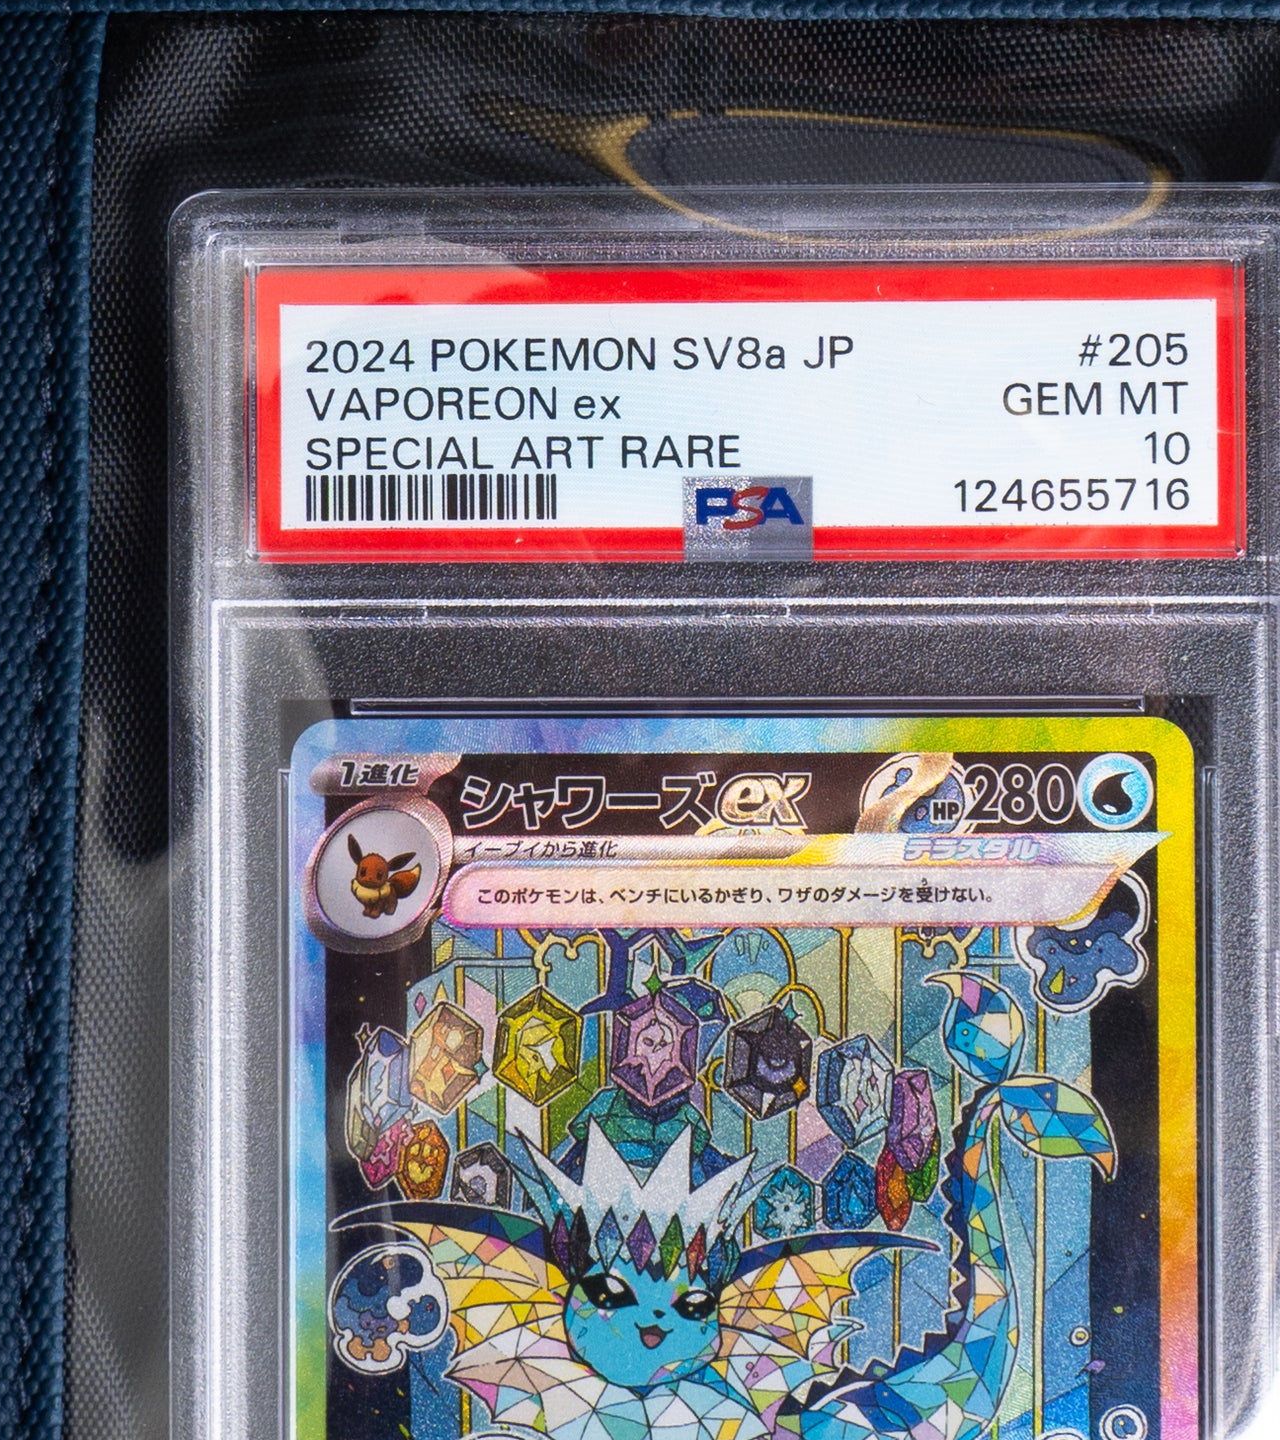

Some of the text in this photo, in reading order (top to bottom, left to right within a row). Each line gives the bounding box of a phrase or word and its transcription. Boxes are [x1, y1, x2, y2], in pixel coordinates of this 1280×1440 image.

[305, 335, 854, 374] 2024 POKEMON SV8a JP
[1078, 332, 1189, 368] #205
[305, 386, 621, 421] VAPOREON ex
[1002, 380, 1189, 417] GEM MT
[305, 434, 742, 471] SPECIAL ART RARE
[1144, 431, 1191, 466] 10
[695, 484, 806, 531] PSA
[953, 477, 1191, 513] 124655716
[338, 760, 420, 787] 1進化
[931, 762, 1077, 825] HP 280
[463, 839, 618, 859] イーブイから進化
[902, 835, 1040, 861] テラスタル
